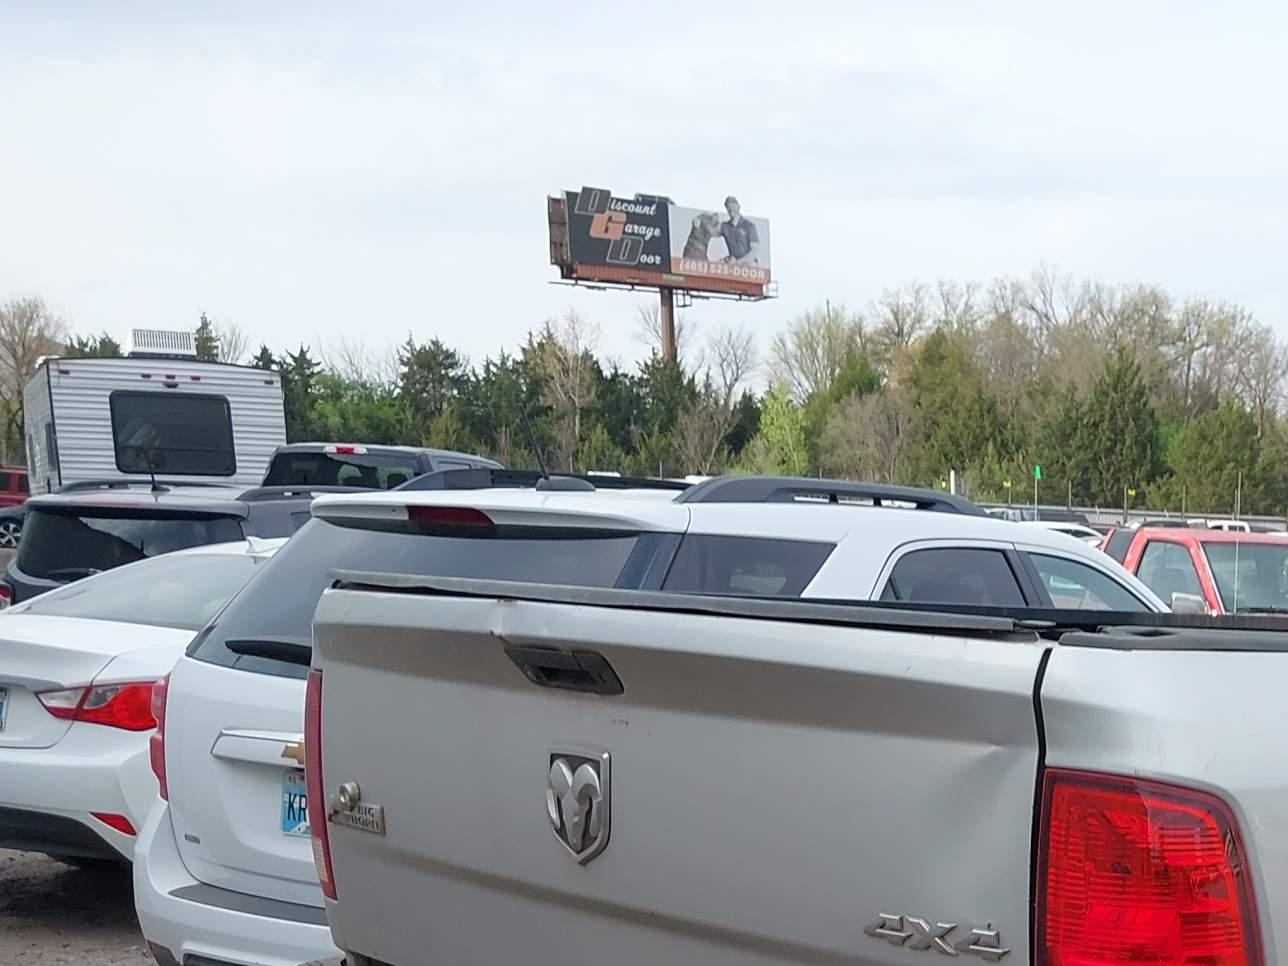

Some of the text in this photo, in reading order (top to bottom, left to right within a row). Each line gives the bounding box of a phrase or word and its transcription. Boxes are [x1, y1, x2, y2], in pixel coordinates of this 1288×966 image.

[574, 186, 656, 216] Discount
[589, 211, 661, 240] Garage
[607, 235, 662, 265] Door
[357, 806, 375, 818] BIG
